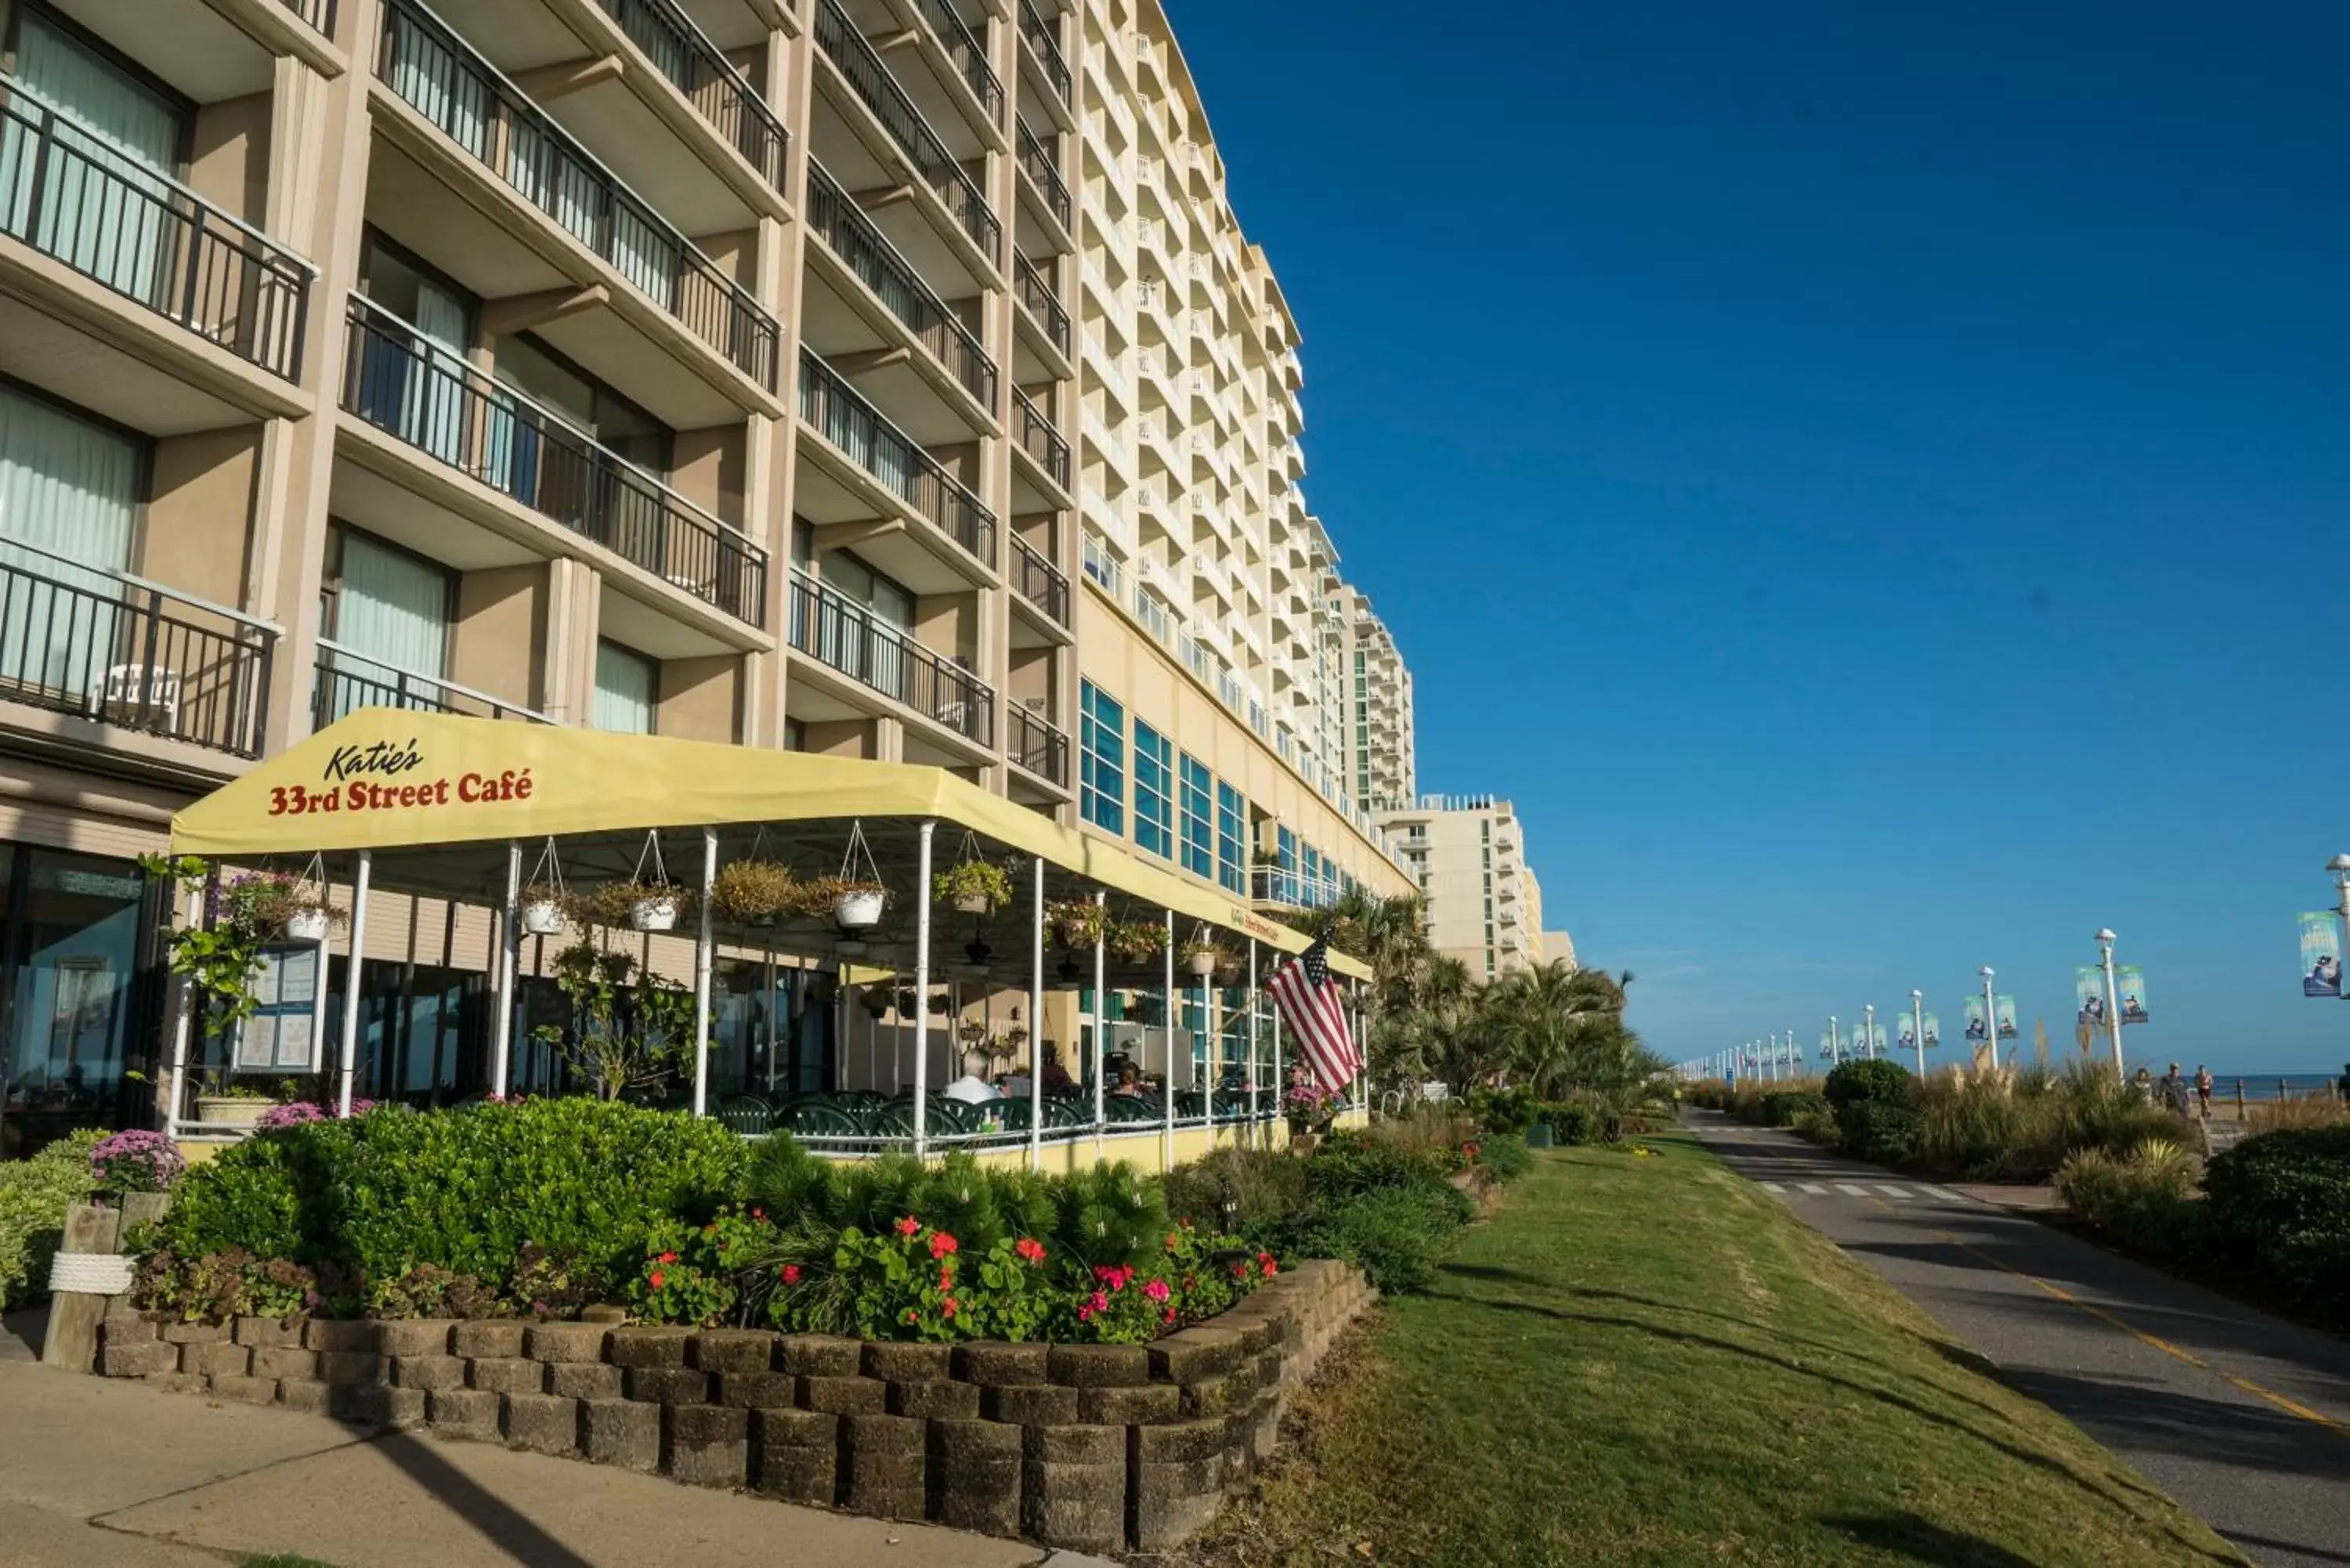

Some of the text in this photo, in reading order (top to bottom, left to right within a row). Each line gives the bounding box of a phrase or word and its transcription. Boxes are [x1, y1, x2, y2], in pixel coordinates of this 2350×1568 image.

[324, 739, 424, 782] Katie's
[268, 768, 533, 815] 33rd Street Café
